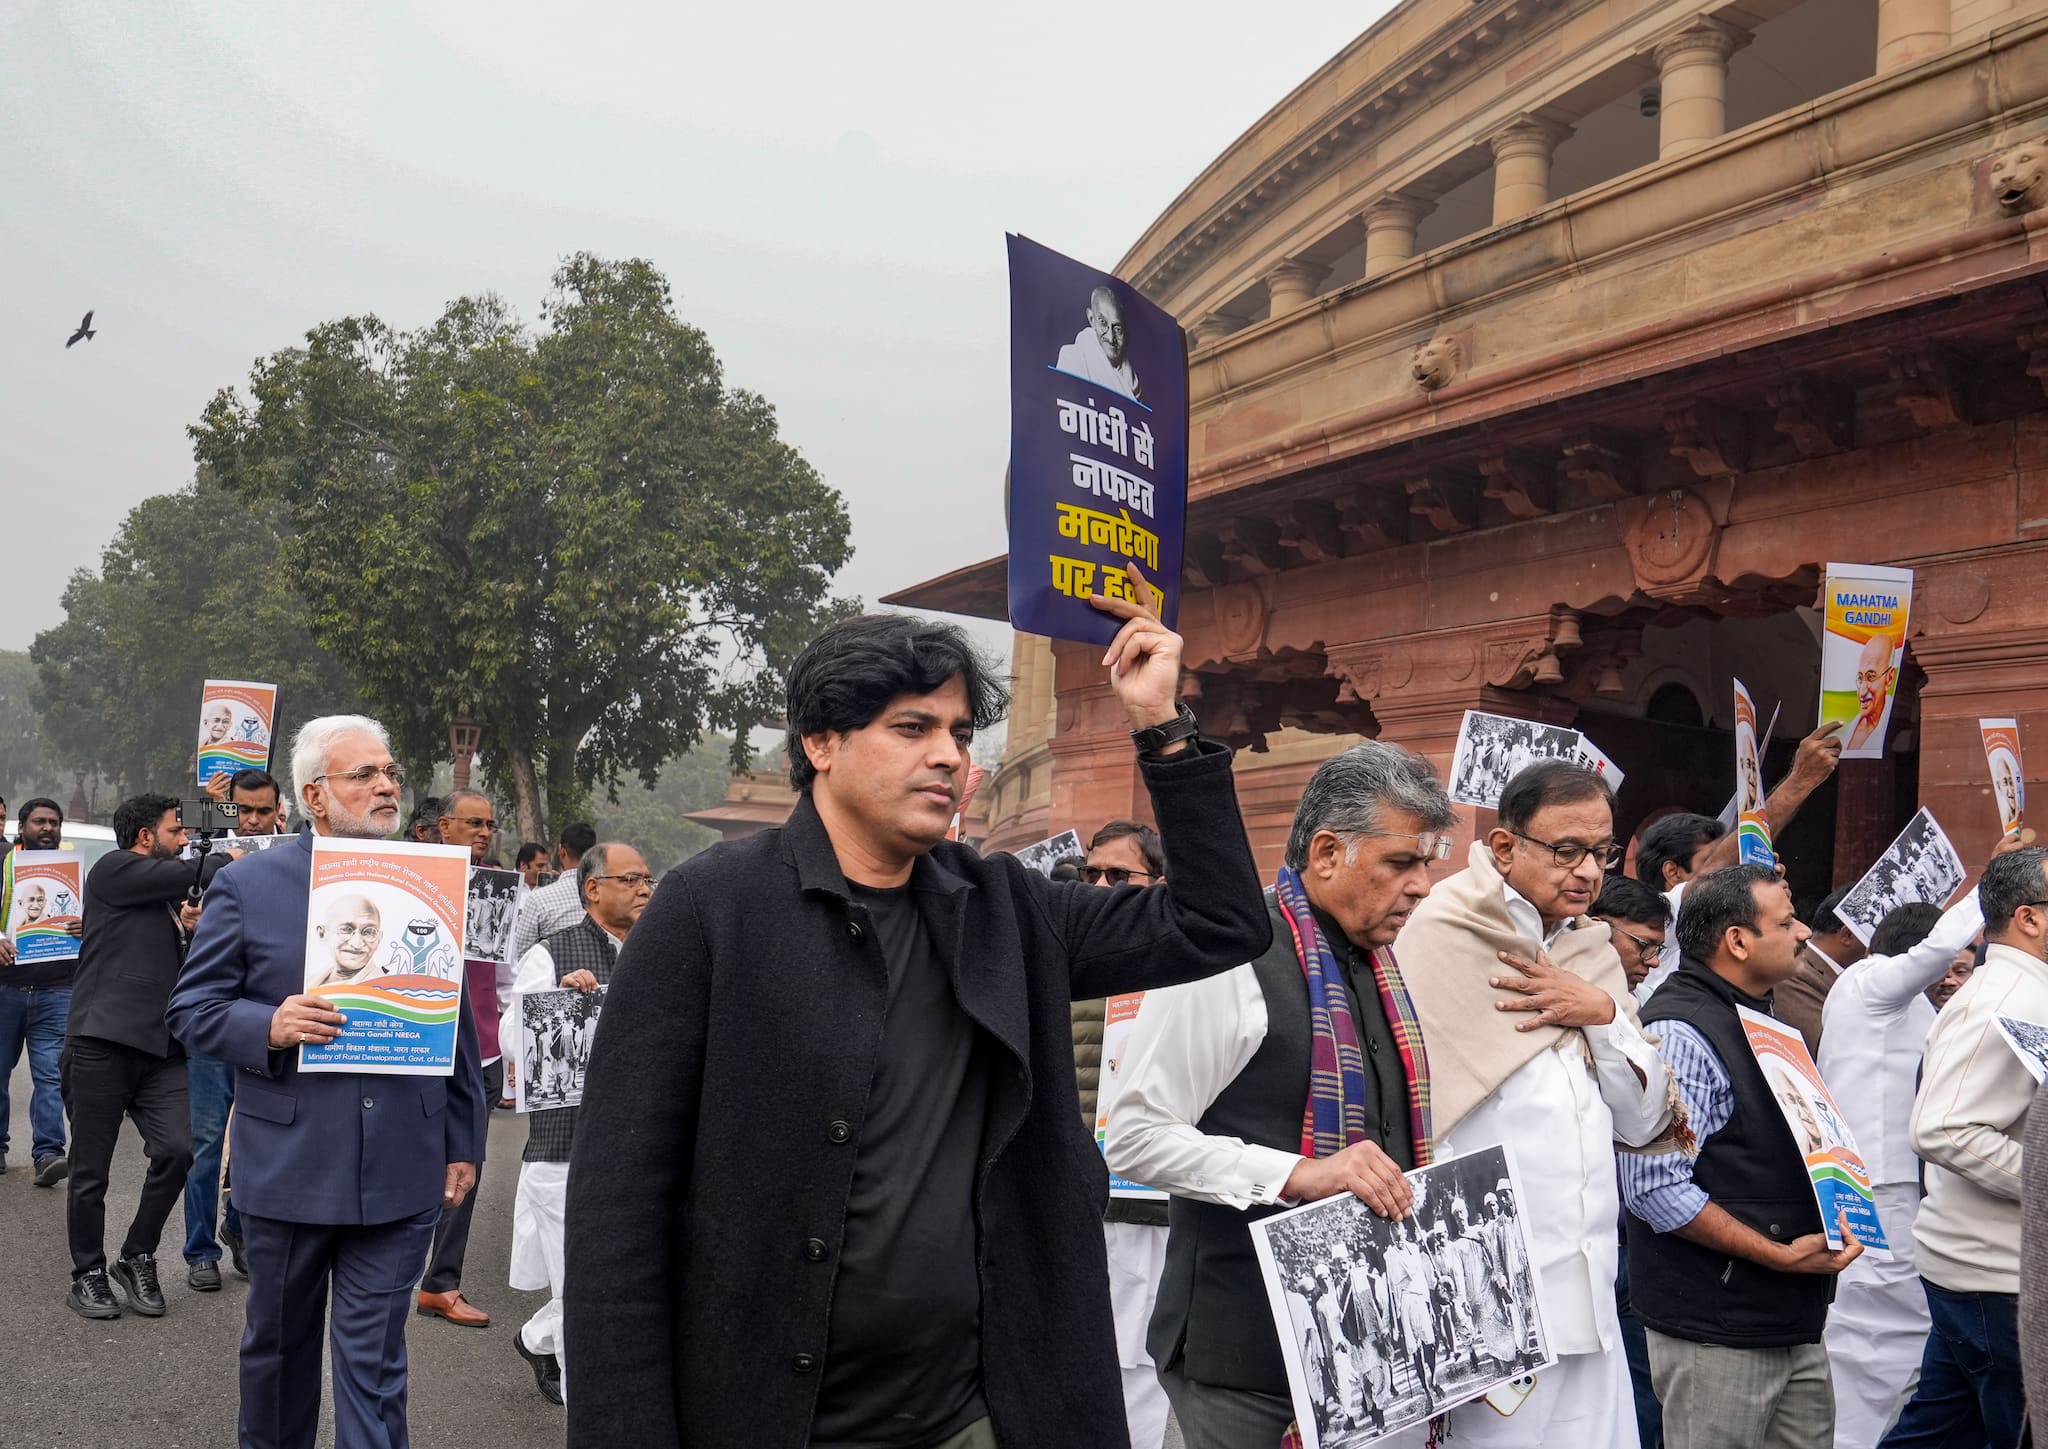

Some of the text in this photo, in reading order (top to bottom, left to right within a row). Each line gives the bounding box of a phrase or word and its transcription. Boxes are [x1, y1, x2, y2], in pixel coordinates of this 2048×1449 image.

[1056, 397, 1155, 470] गांधी से
[1069, 453, 1155, 519] नफरत
[1055, 501, 1160, 572] मनरेगा
[1049, 554, 1096, 601] पर
[1837, 593, 1898, 608] MAHATMA
[1845, 611, 1891, 625] GANDHI
[374, 1019, 388, 1028] गांधी
[340, 1030, 421, 1039] hatma Gandhi NREGA
[308, 1053, 333, 1062] Ministry
[361, 1054, 407, 1063] Development,
[408, 1055, 425, 1063] Govt.
[426, 1055, 434, 1063] of
